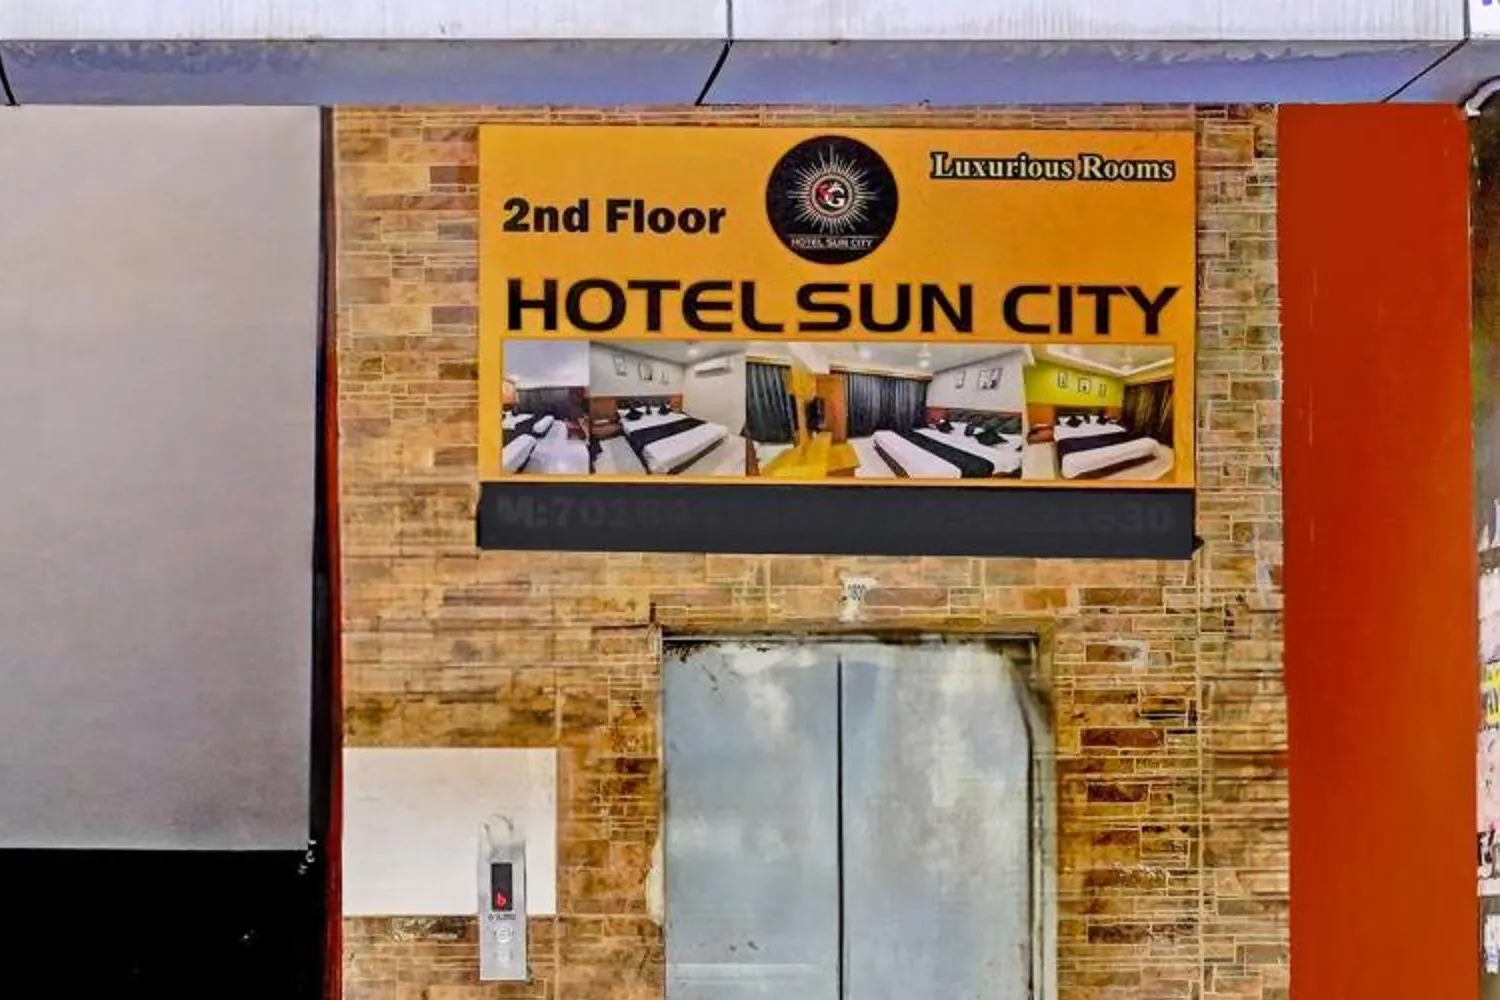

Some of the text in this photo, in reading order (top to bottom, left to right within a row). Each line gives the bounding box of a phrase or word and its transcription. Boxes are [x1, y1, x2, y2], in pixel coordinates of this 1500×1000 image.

[932, 152, 1176, 182] Luxurious Rooms
[503, 198, 726, 234] 2nd Floor
[791, 239, 873, 249] HOTEL SUN CITY
[507, 278, 1181, 335] HOTEL SUN CITY
